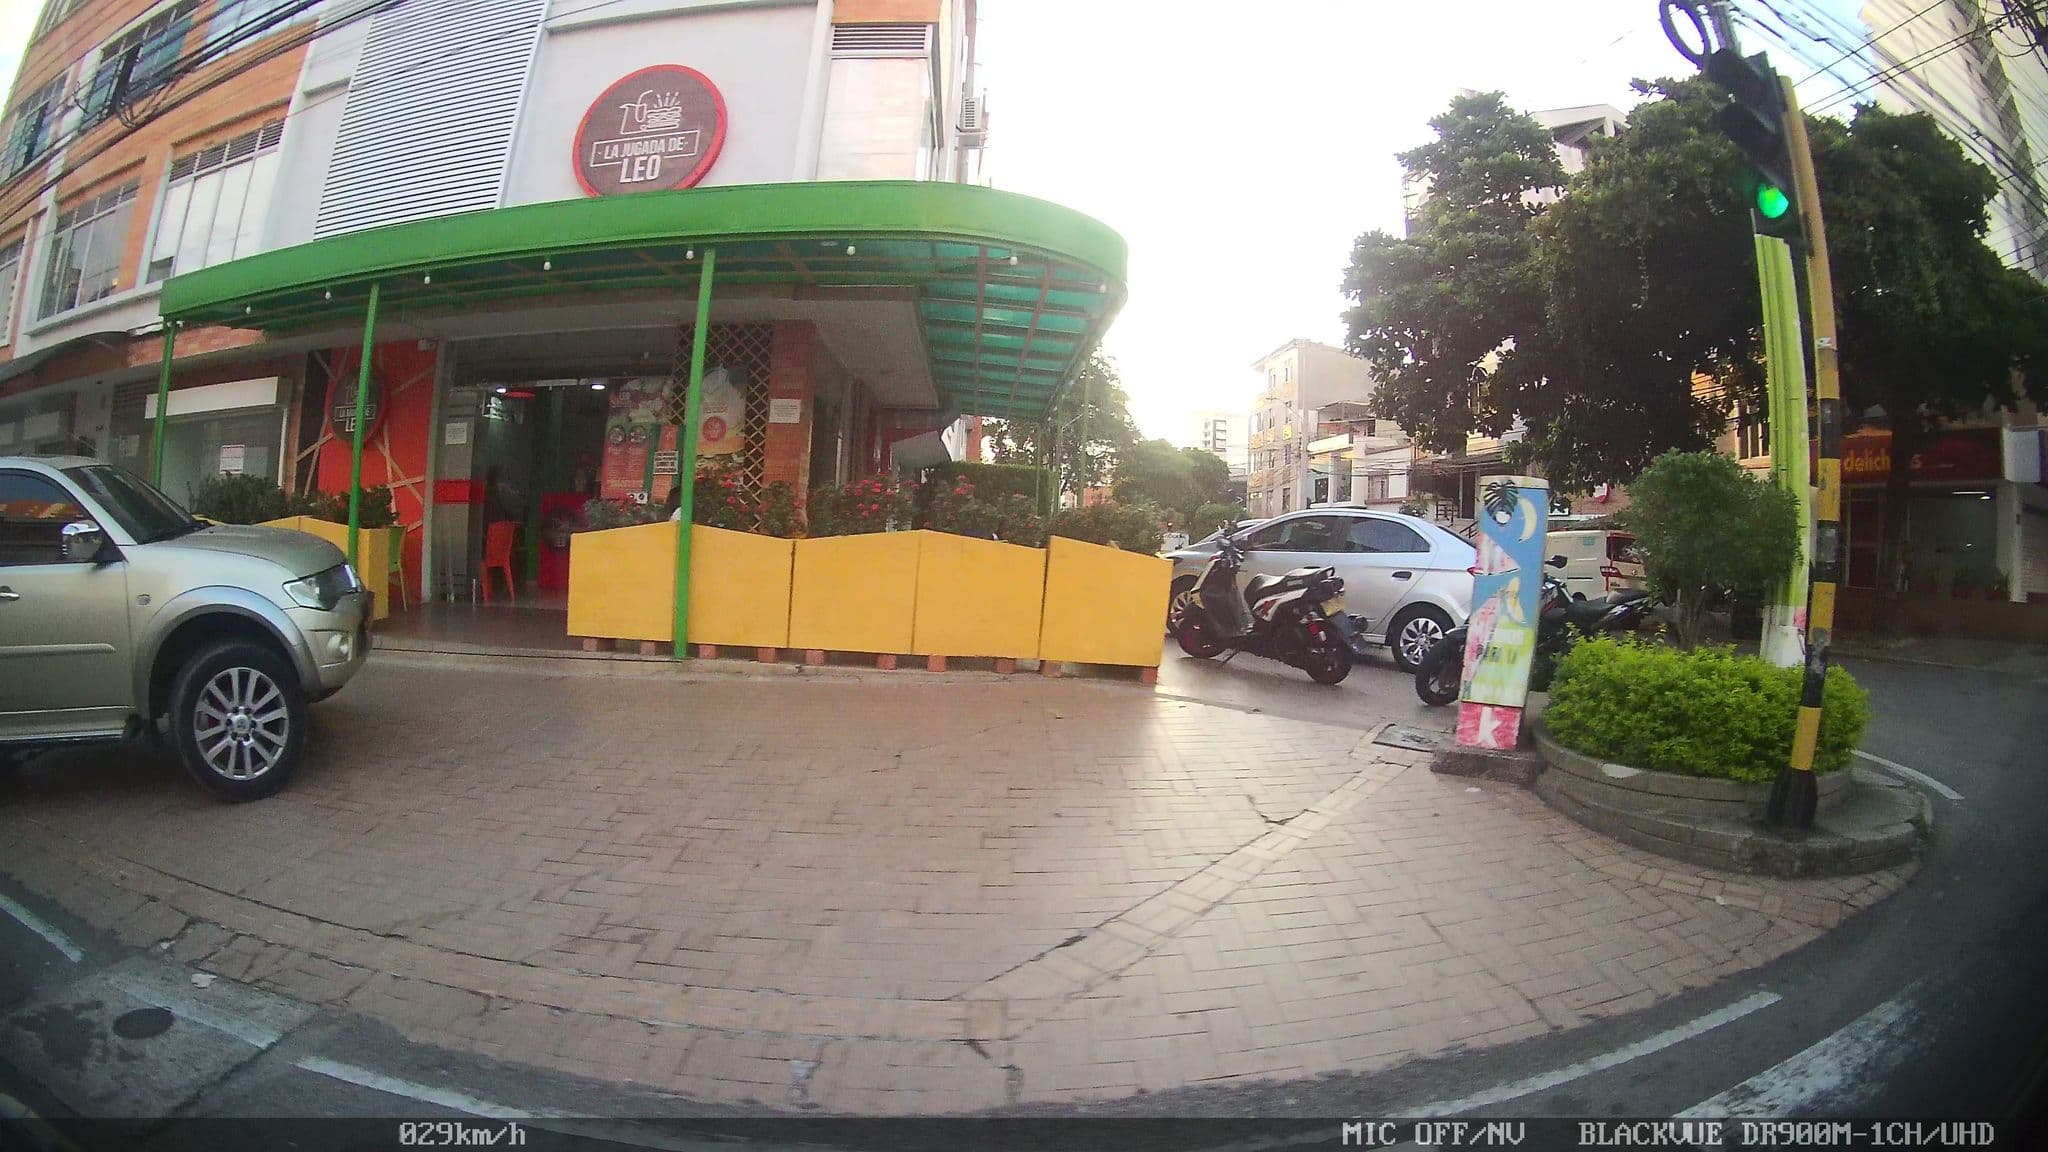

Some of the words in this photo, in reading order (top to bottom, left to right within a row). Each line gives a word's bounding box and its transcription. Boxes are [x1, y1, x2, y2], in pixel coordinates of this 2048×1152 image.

[603, 143, 619, 160] LA
[620, 138, 666, 158] JUGADA
[667, 136, 686, 152] DE
[619, 154, 661, 184] LEO
